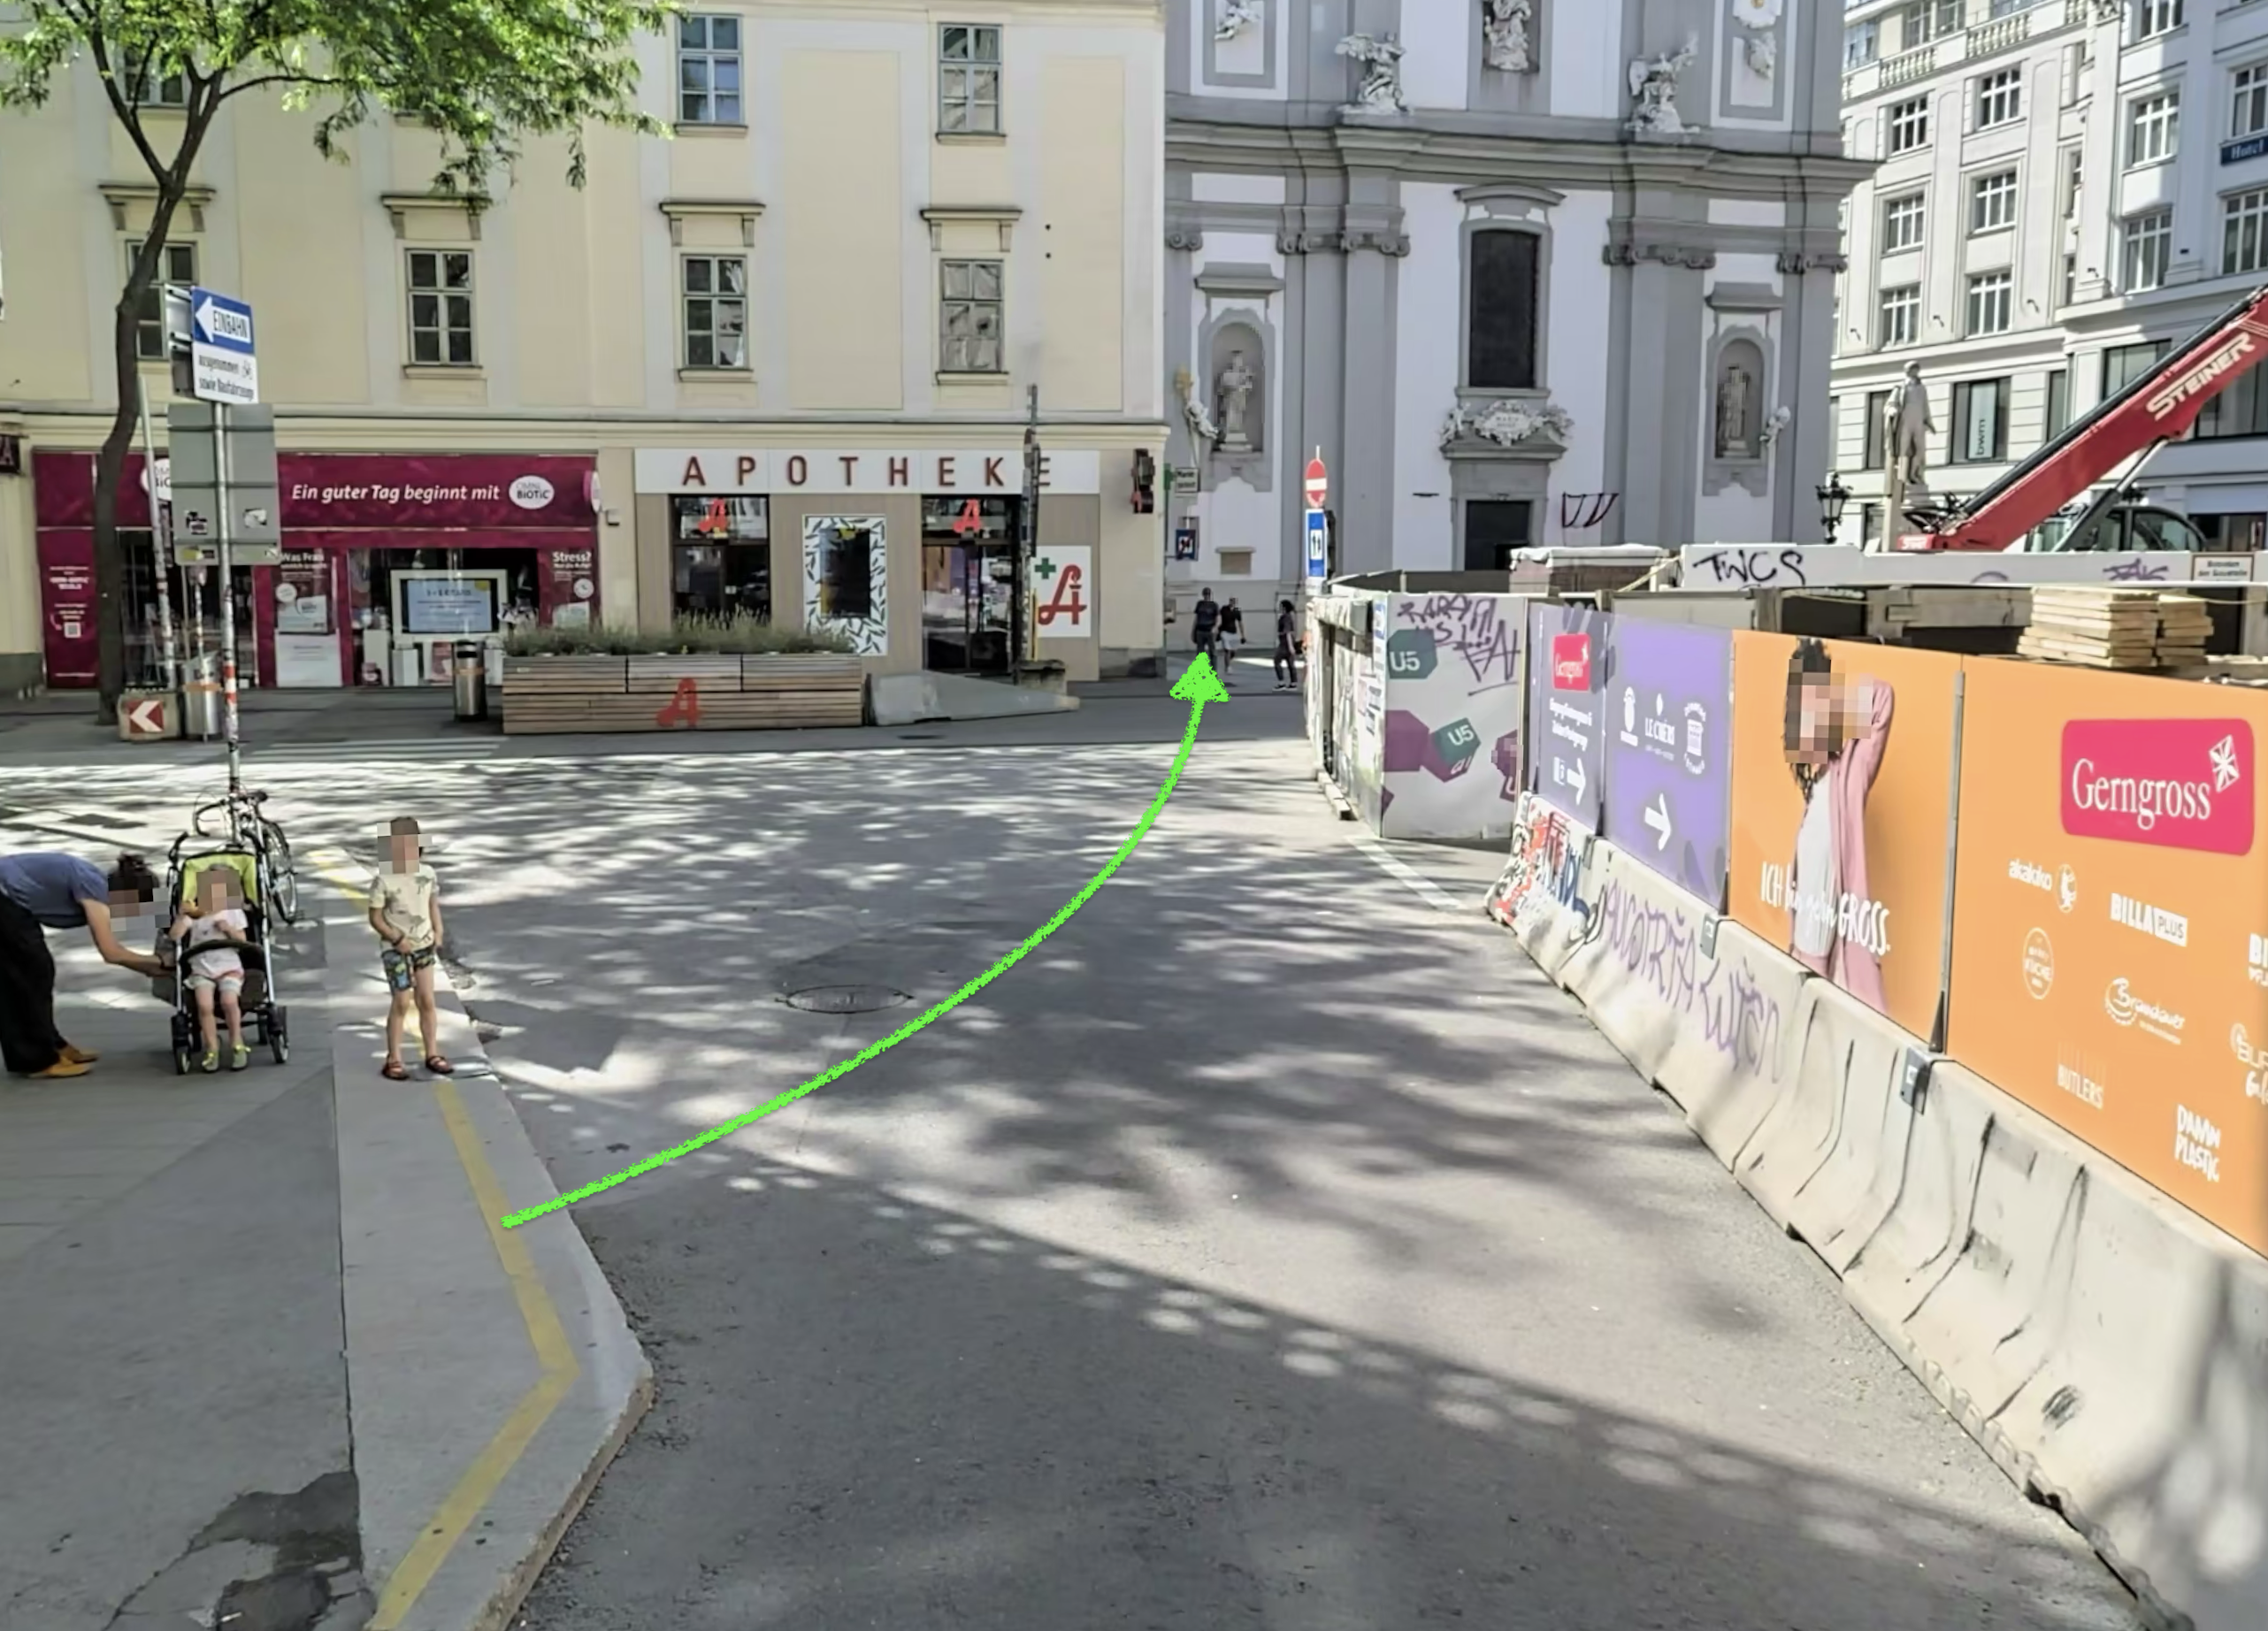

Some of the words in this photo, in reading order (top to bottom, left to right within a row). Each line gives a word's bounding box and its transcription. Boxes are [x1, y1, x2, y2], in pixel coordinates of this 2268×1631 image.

[2146, 332, 2256, 421] STEINER
[682, 456, 1051, 486] APOTHEKE
[292, 485, 318, 500] Ein
[322, 486, 367, 505] guter
[372, 485, 400, 503] Tag
[404, 484, 467, 505] beginnt
[471, 485, 500, 500] mit
[553, 551, 592, 563] Stress?
[1389, 651, 1421, 671] U5
[1447, 724, 1474, 746] U5
[2073, 758, 2211, 831] Gerngross
[1837, 892, 1891, 956] GROSS.
[2110, 892, 2153, 935] BILLA
[2157, 915, 2184, 940] PLUS
[2057, 1064, 2103, 1110] BUTLERS
[2177, 1103, 2221, 1148] DAMN
[2174, 1133, 2220, 1183] PLASTIC
